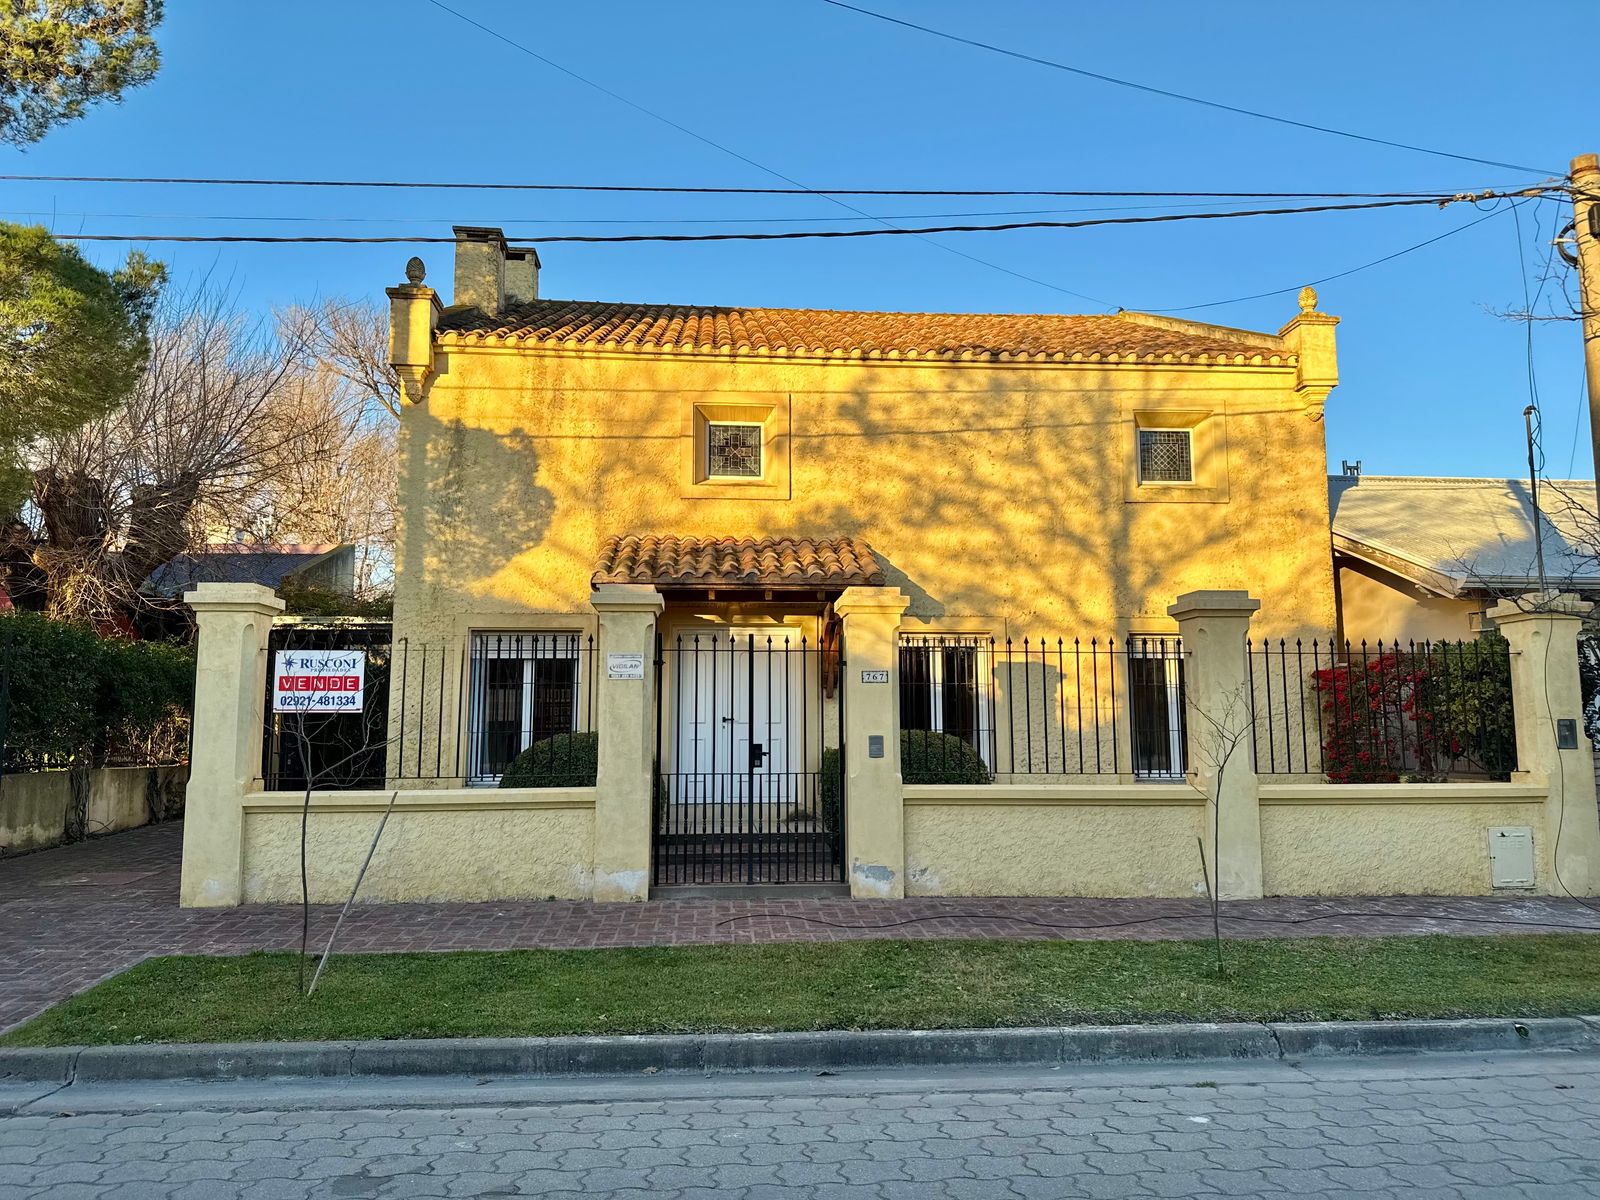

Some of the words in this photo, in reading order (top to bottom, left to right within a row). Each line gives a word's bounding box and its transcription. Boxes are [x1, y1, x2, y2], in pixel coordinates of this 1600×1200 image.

[300, 658, 357, 669] RUSCONI
[282, 678, 356, 689] VENDE
[280, 696, 356, 706] 02921-481334
